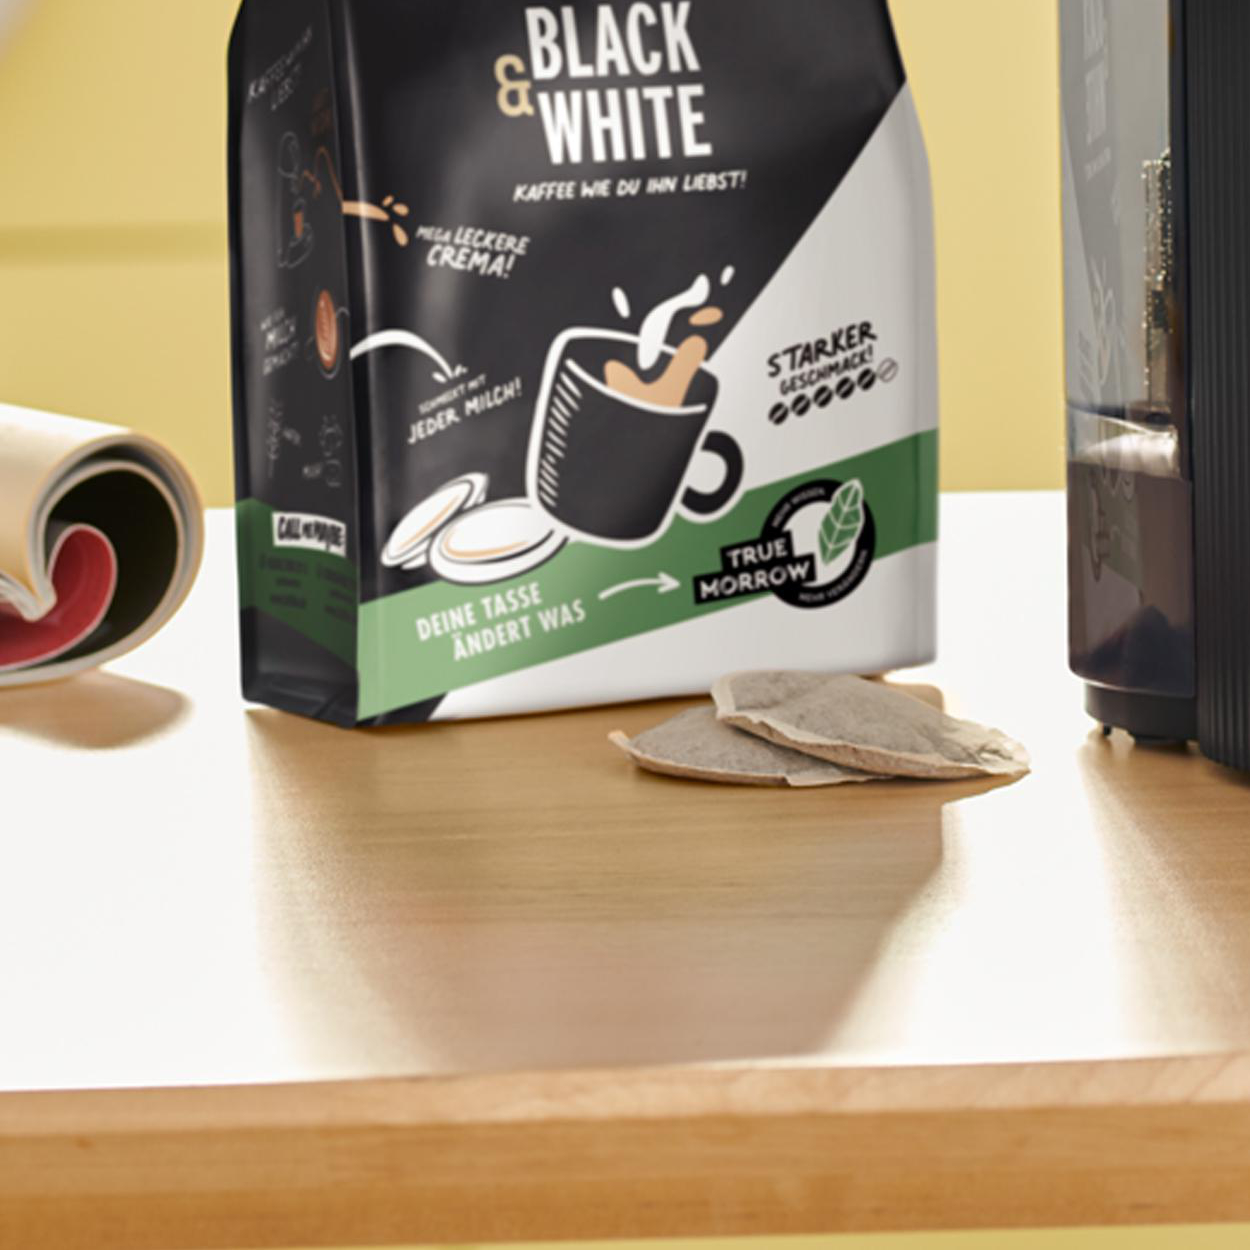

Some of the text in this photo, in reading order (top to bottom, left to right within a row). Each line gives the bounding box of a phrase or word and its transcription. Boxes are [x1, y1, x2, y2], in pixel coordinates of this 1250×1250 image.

[525, 0, 701, 80] BLACK
[494, 54, 534, 117] &
[537, 84, 713, 165] WHITE
[513, 170, 747, 202] KAFFEE WIE DU IHN LIEBST!
[426, 244, 516, 279] CREMA!
[453, 226, 531, 256] LECKERE
[767, 321, 878, 378] STARKER
[780, 343, 874, 396] GESCHMACK!
[407, 376, 522, 444] JEDER MILCH!
[700, 561, 810, 599] MORROW
[727, 538, 788, 568] TRUE
[415, 582, 543, 641] DEINE TASSE
[451, 599, 586, 661] ÄNDERT WAS
